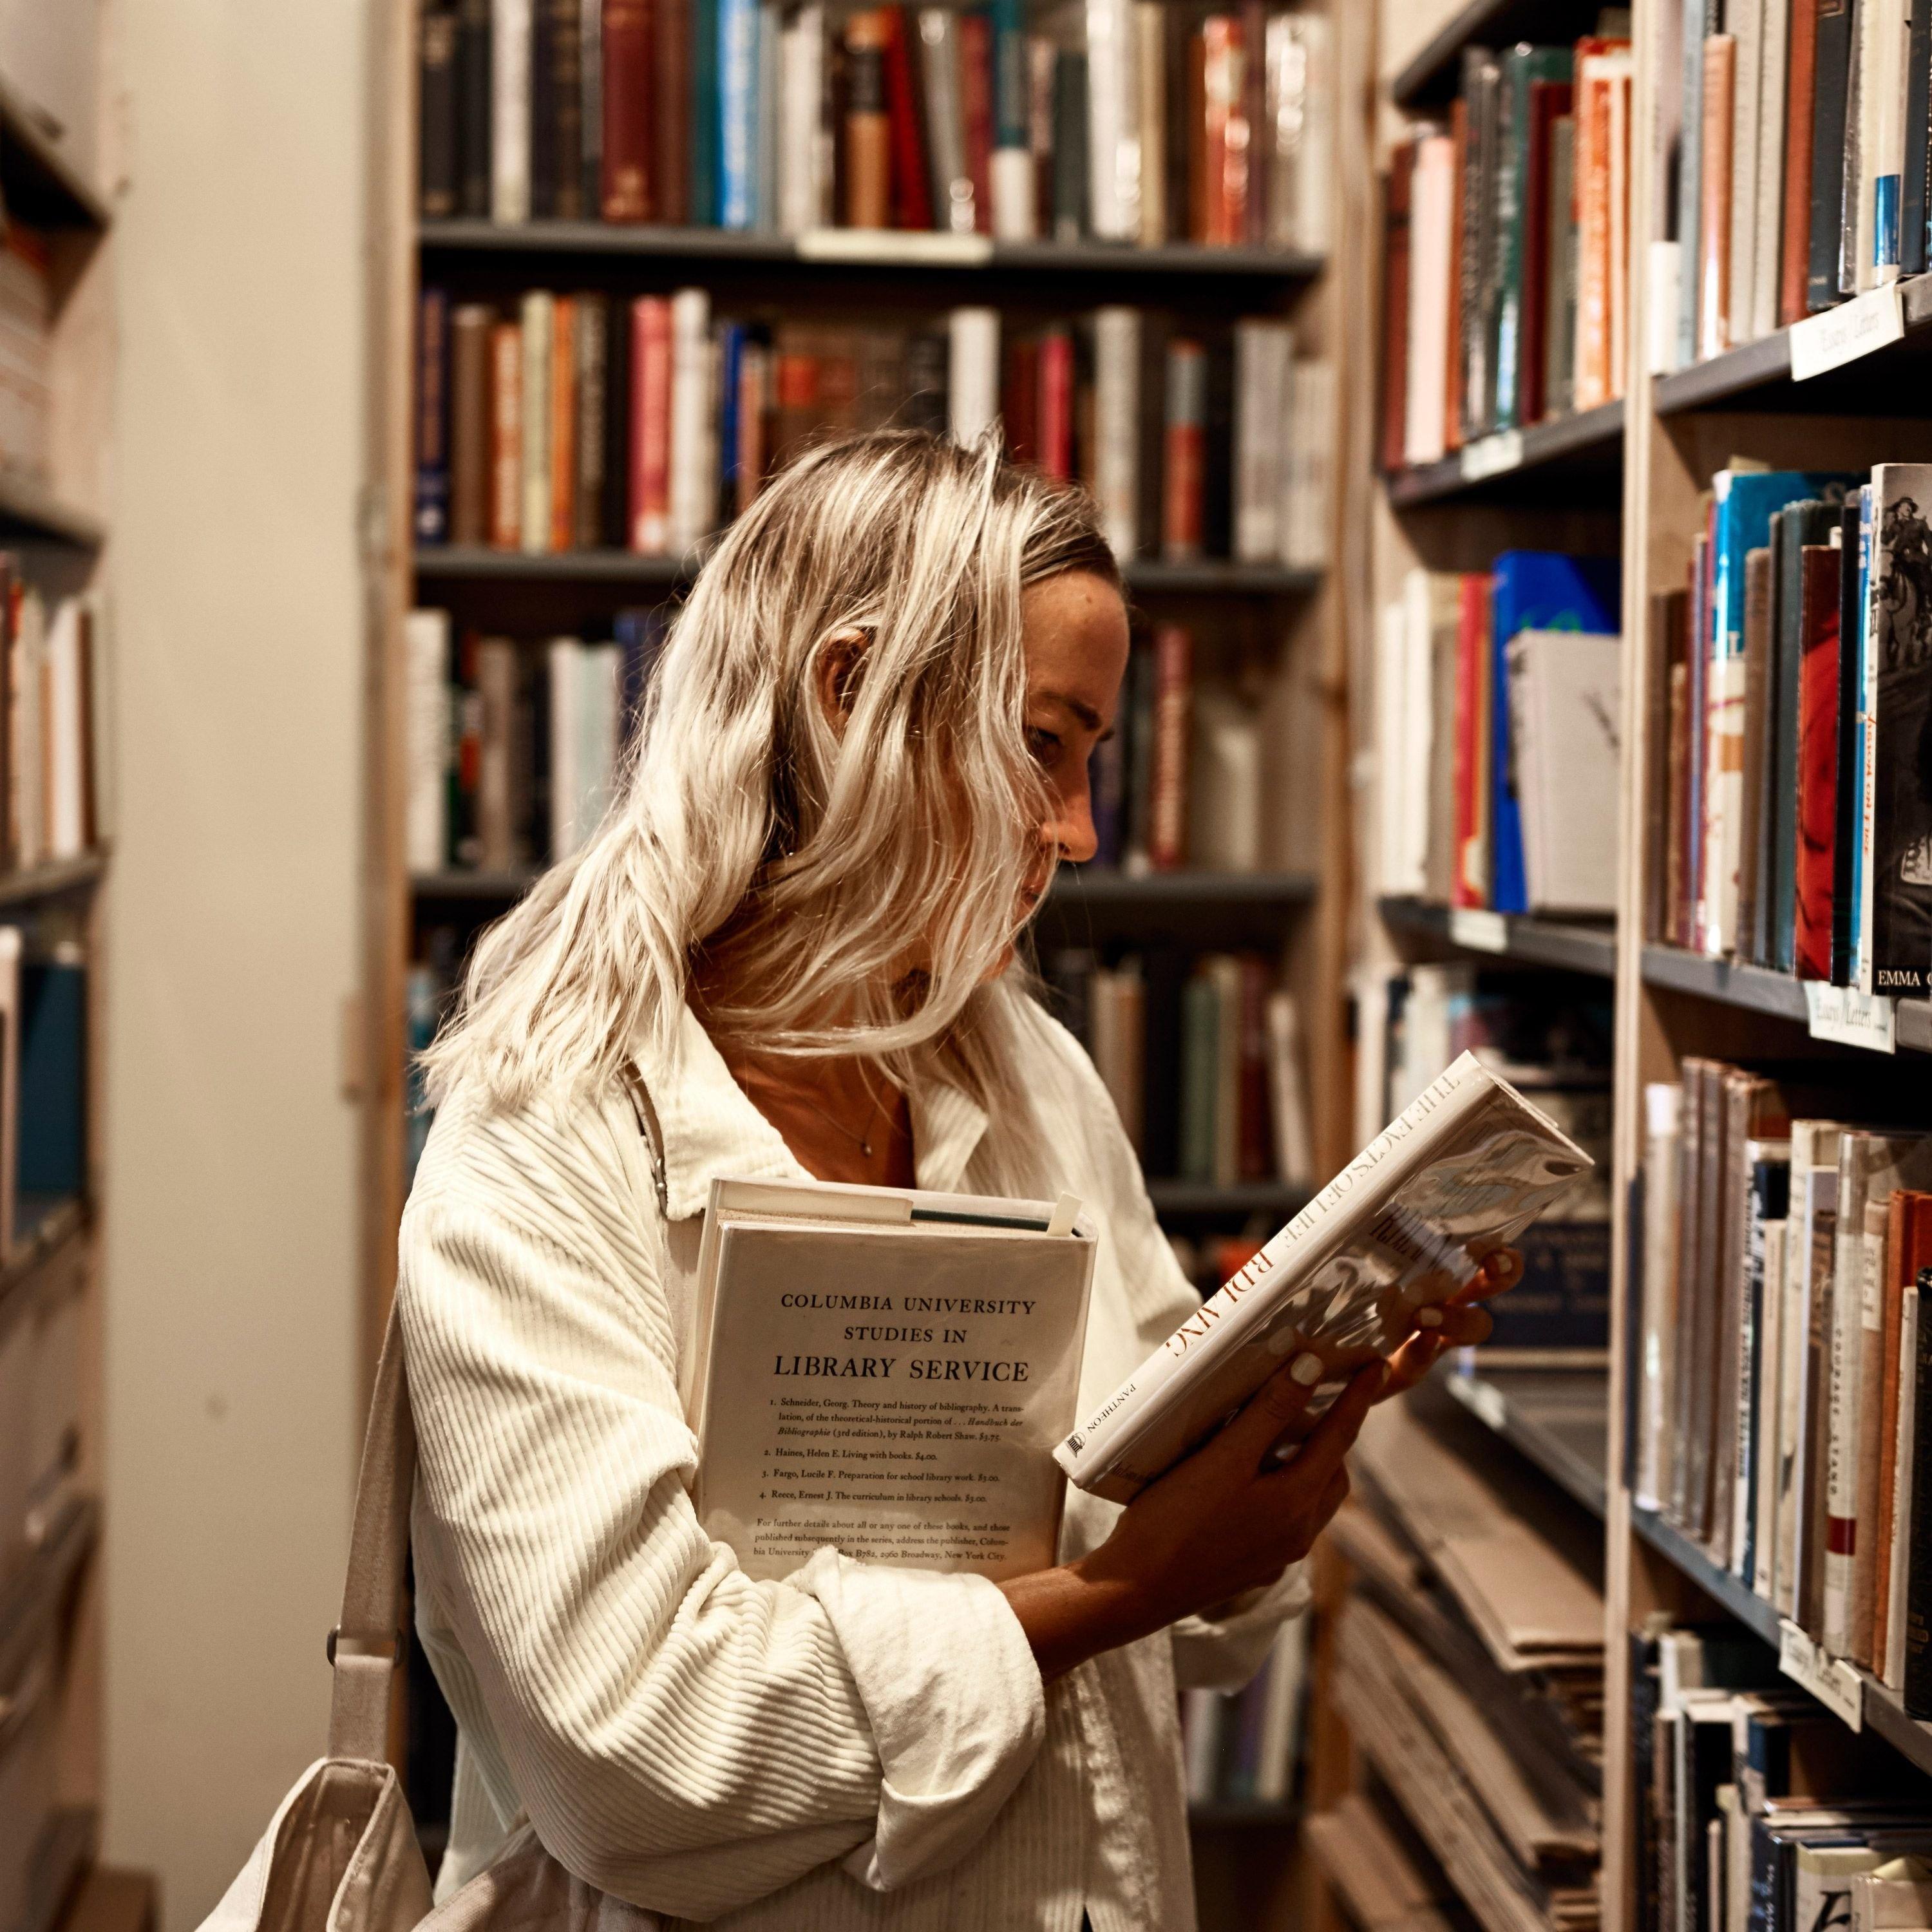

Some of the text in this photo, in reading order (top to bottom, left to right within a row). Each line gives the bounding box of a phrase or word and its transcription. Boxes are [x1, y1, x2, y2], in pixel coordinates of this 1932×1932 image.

[1878, 970, 1920, 987] EMMA
[1409, 1075, 1461, 1121] THE
[1351, 1115, 1413, 1177] FACTS
[1328, 1173, 1353, 1205] OF
[1278, 1198, 1328, 1248] LIFE
[781, 1293, 1037, 1316] COLUMBIA UNIVERSITY
[844, 1326, 967, 1343] STUDIES IN
[773, 1355, 1030, 1383] LIBRARY SERVICE
[781, 1398, 821, 1407] Schneider,
[823, 1399, 849, 1410] Georg.
[852, 1399, 880, 1410] Theory
[900, 1401, 927, 1412] history
[929, 1402, 938, 1410] of
[939, 1403, 990, 1414] bibliography.
[1086, 1383, 1136, 1433] PANTHEON
[779, 1412, 804, 1422] lation,
[831, 1414, 911, 1424] theoretical-historical
[913, 1417, 942, 1426] portion
[967, 1417, 1007, 1426] Handbuch
[777, 1427, 831, 1437] Bibliographie
[833, 1428, 849, 1437] (3rd
[851, 1429, 886, 1439] edition),
[887, 1430, 898, 1440] by
[900, 1430, 923, 1441] Ralph
[954, 1432, 978, 1440] Shaw.
[775, 1448, 805, 1458] Haines,
[806, 1449, 830, 1457] Helen
[842, 1450, 868, 1461] Living
[869, 1450, 887, 1459] with
[889, 1451, 913, 1459] books.
[773, 1469, 799, 1480] Fargo,
[801, 1470, 825, 1478] Lucile
[828, 1470, 836, 1479] F.
[838, 1470, 884, 1481] Preparation
[886, 1472, 898, 1480] for
[900, 1472, 924, 1481] school
[926, 1473, 952, 1483] library
[772, 1490, 797, 1500] Reece,
[799, 1491, 824, 1499] Ernest
[826, 1491, 833, 1501] J.
[835, 1492, 851, 1500] The
[852, 1492, 895, 1501] curriculum
[905, 1493, 933, 1504] library
[757, 1518, 772, 1526] For
[773, 1519, 801, 1527] further
[804, 1520, 829, 1528] details
[832, 1520, 854, 1529] about
[946, 1522, 971, 1531] books,
[990, 1523, 1010, 1531] those
[755, 1533, 793, 1543] published
[794, 1534, 846, 1544] subsequently
[871, 1536, 895, 1544] series,
[940, 1537, 978, 1546] publisher,
[768, 1548, 810, 1558] University
[855, 1549, 877, 1558] B782,
[902, 1551, 942, 1560] Broadway,
[965, 1551, 984, 1560] York
